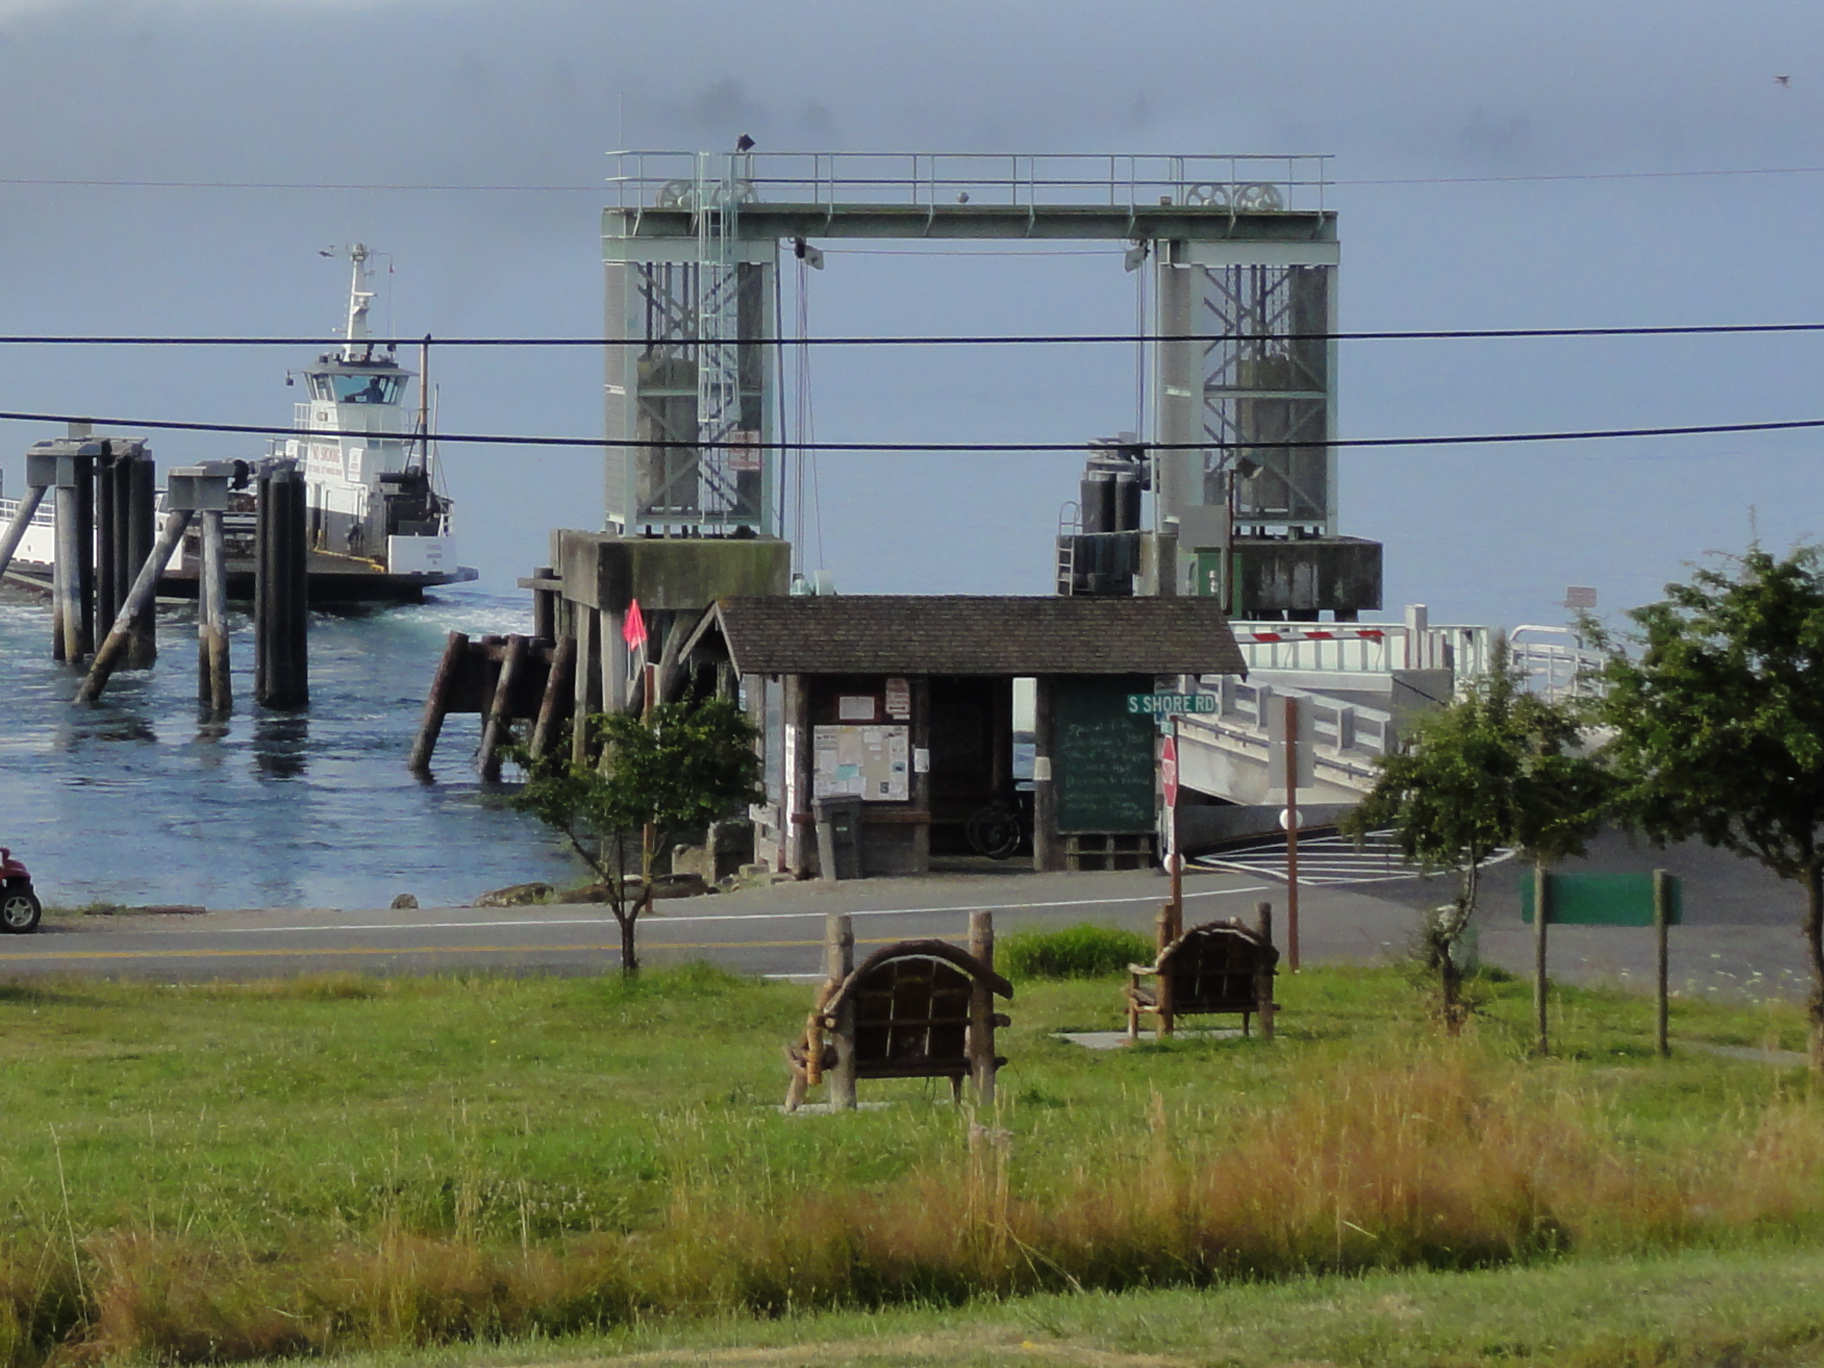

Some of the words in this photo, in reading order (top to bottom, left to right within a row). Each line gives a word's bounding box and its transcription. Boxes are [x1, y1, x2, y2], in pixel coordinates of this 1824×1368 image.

[1129, 696, 1139, 713] S
[1142, 696, 1192, 713] SHORE
[1195, 695, 1214, 712] RD
